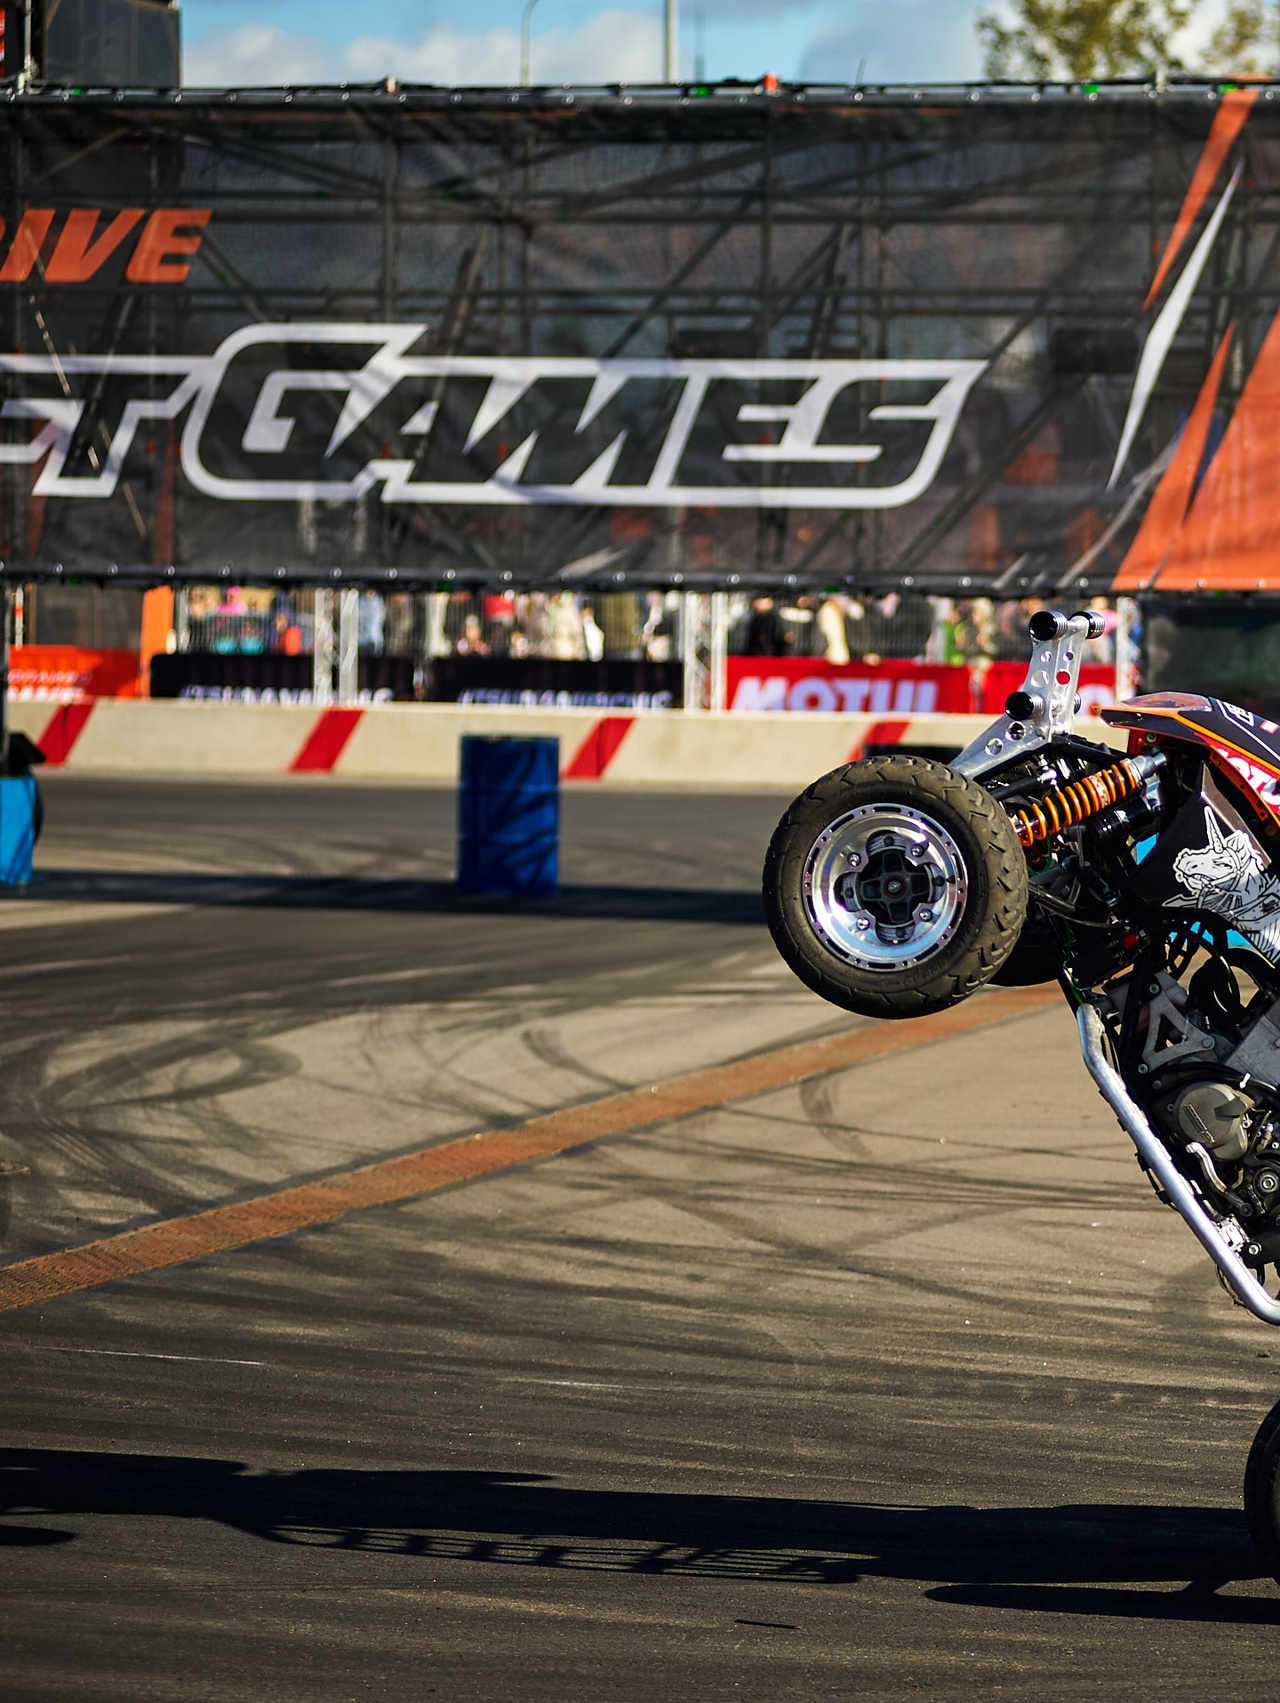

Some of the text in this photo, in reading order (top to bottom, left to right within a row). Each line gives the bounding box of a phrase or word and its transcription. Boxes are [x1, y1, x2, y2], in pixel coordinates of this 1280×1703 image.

[0, 208, 214, 282] IVE
[182, 323, 988, 507] GAMES
[731, 677, 939, 713] MOTUL
